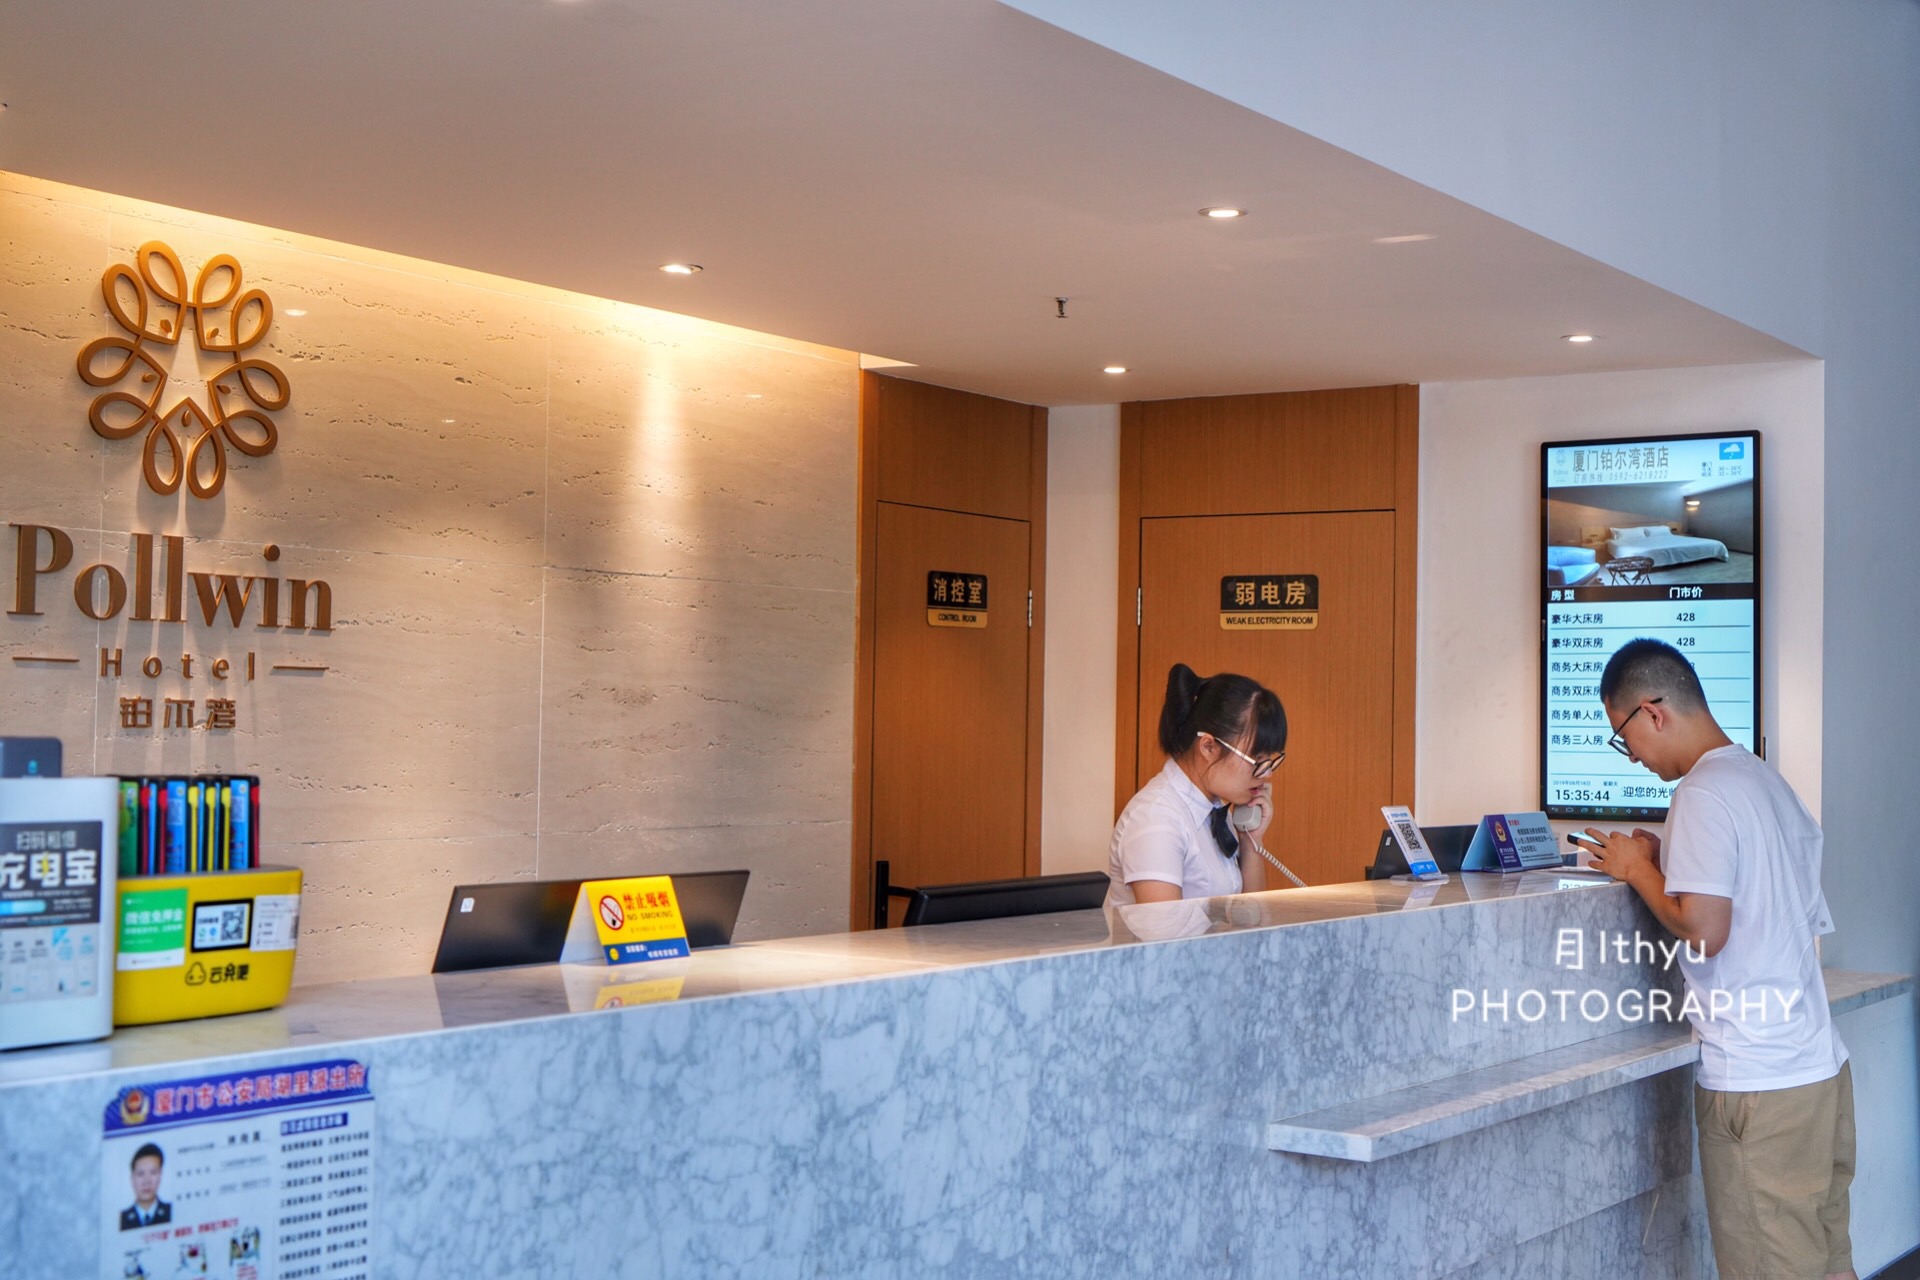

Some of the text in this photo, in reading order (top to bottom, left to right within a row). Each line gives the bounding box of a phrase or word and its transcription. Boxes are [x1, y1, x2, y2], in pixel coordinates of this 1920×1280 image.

[1573, 446, 1669, 472] 厦门铂尔湾酒店
[7, 522, 335, 631] Pollwin
[933, 578, 982, 604] 消控室
[1235, 581, 1307, 606] 弱电房
[1551, 586, 1703, 601] 房型 门市价
[938, 613, 977, 623] CONTROL ROOM
[1226, 616, 1313, 625] WEAK ELECTRICITY ROOM
[1551, 612, 1696, 624] 豪华大床房 428
[1551, 637, 1696, 648] 豪华双床房 428
[99, 648, 256, 681] Hotel
[1551, 661, 1603, 673] 商务大床房
[120, 695, 236, 730] 铂尔湾
[1551, 709, 1603, 721] 商务单人房
[1551, 734, 1603, 746] 商务三人房
[1555, 789, 1610, 801] 15:35:44
[0, 849, 97, 890] 充电宝
[626, 910, 673, 921] NO SMOKING
[154, 1064, 366, 1116] 厦门市公安局湖里派出所
